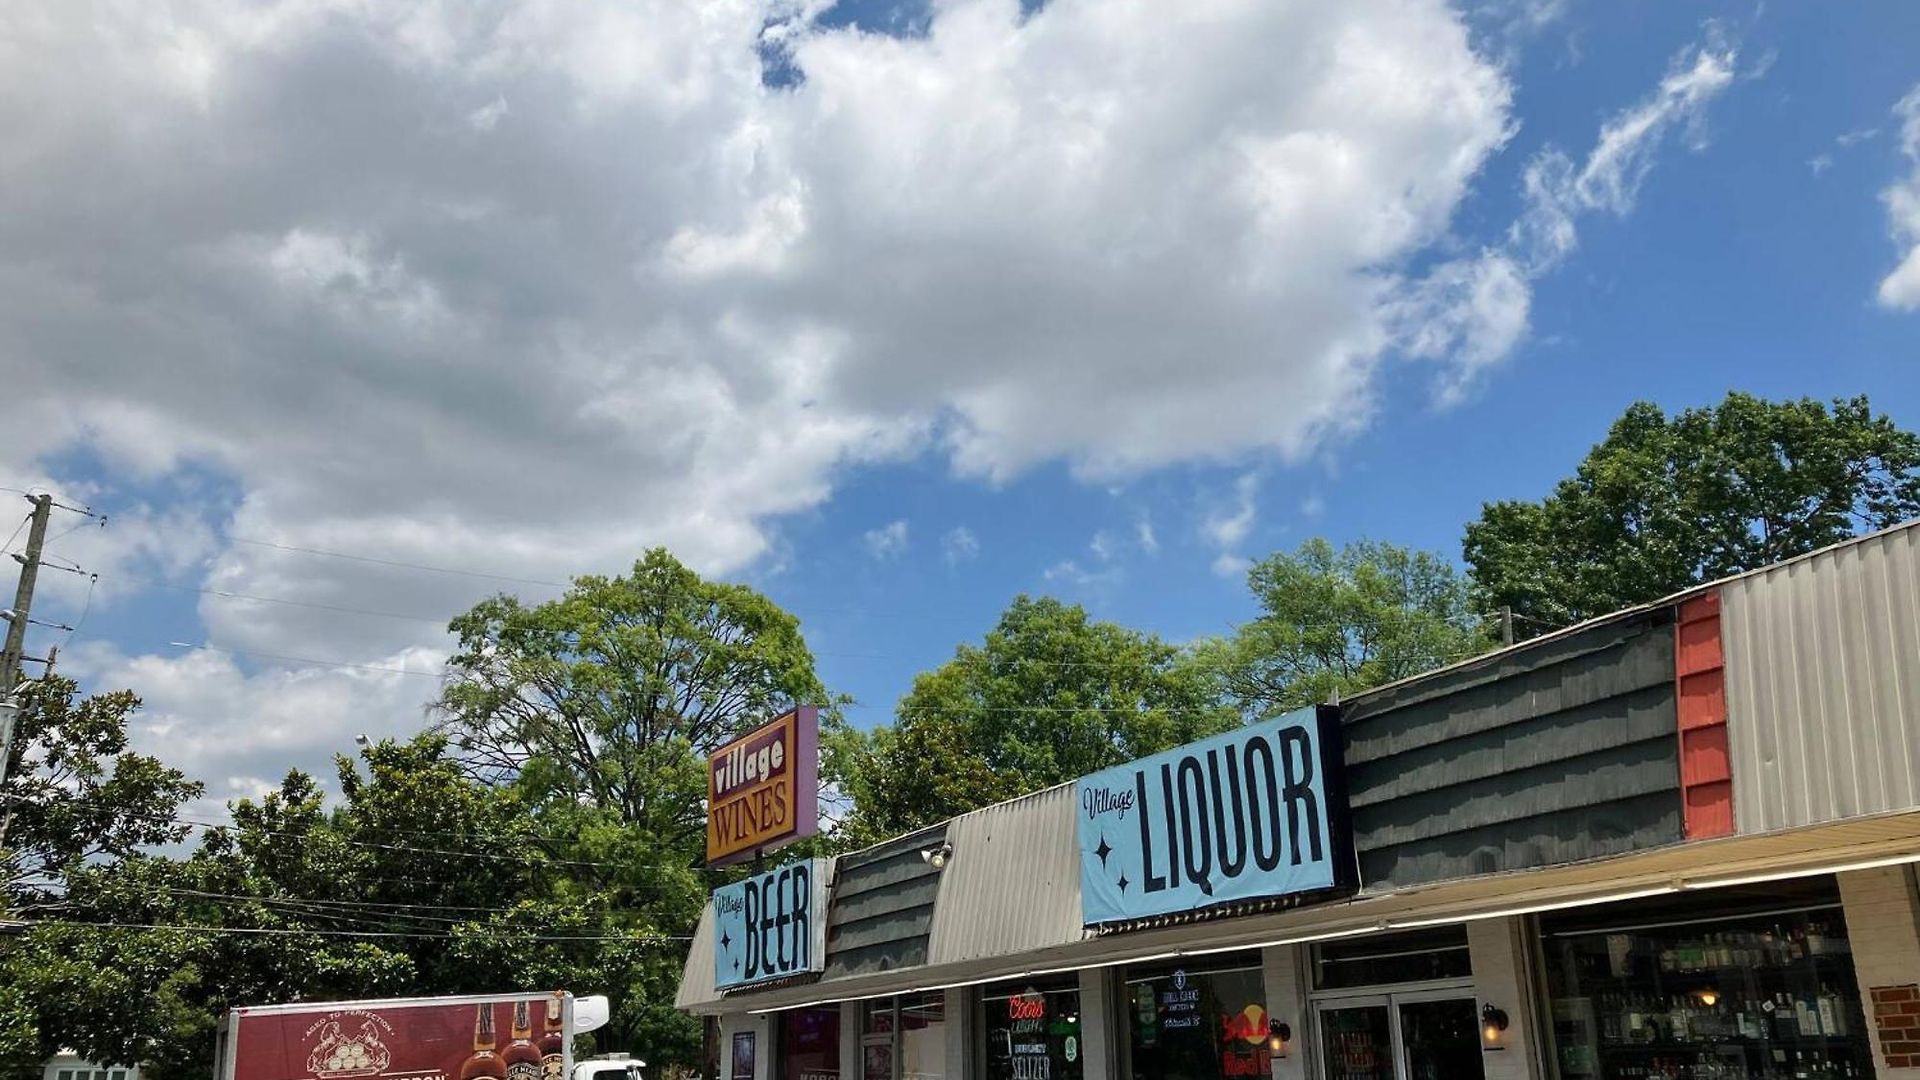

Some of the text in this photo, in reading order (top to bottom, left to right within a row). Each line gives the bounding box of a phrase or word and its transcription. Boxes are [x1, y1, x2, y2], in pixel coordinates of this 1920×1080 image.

[715, 739, 785, 794] village
[713, 780, 787, 849] WINES
[1083, 787, 1136, 820] Village
[1136, 725, 1323, 897] LIQUOR
[715, 895, 744, 920] Village
[744, 865, 809, 980] BEER
[329, 1012, 341, 1020] TO
[344, 1009, 393, 1032] PERFECTION
